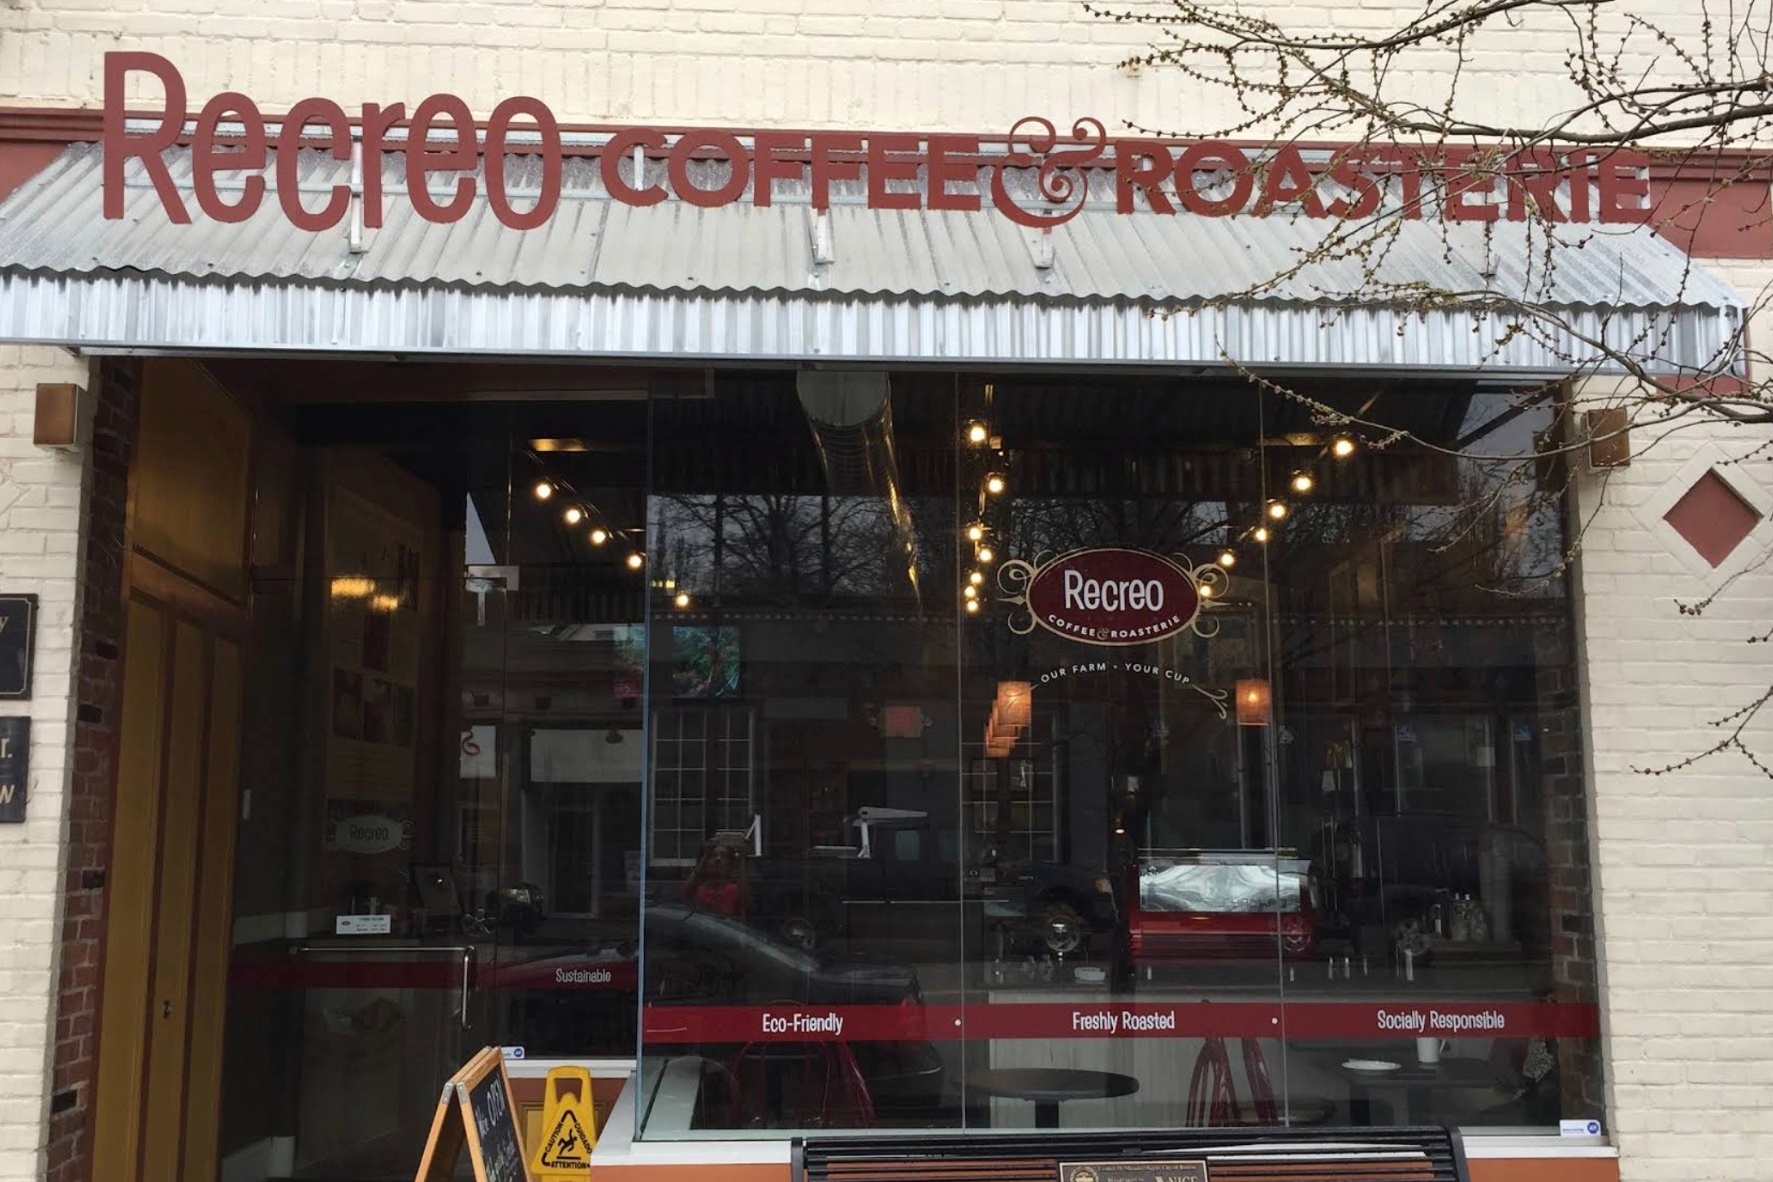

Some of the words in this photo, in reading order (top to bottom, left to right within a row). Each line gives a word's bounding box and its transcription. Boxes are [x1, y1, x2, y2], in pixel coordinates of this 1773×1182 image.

[104, 51, 562, 231] Recreo
[600, 128, 981, 211] COFFEE
[991, 116, 1107, 228] &
[1115, 140, 1652, 223] ROASTERIE
[1064, 569, 1164, 611] Recreo
[1048, 614, 1096, 637] COFFEE
[1111, 615, 1180, 638] ROASTERIE
[1040, 668, 1067, 683] OUR
[1072, 662, 1106, 673] FARM
[1125, 663, 1159, 675] YOUR
[1165, 670, 1190, 684] CUP
[555, 968, 611, 984] Sustainable
[762, 1013, 843, 1035] Eco-Friendly
[1072, 1011, 1118, 1033] Freshly
[1122, 1011, 1175, 1030] Roasted
[1377, 1010, 1426, 1033] Socially
[1430, 1010, 1505, 1032] Responsible
[545, 1121, 563, 1153] CAUTION
[574, 1122, 593, 1154] CUIDADO
[551, 1161, 587, 1169] ATTENTION
